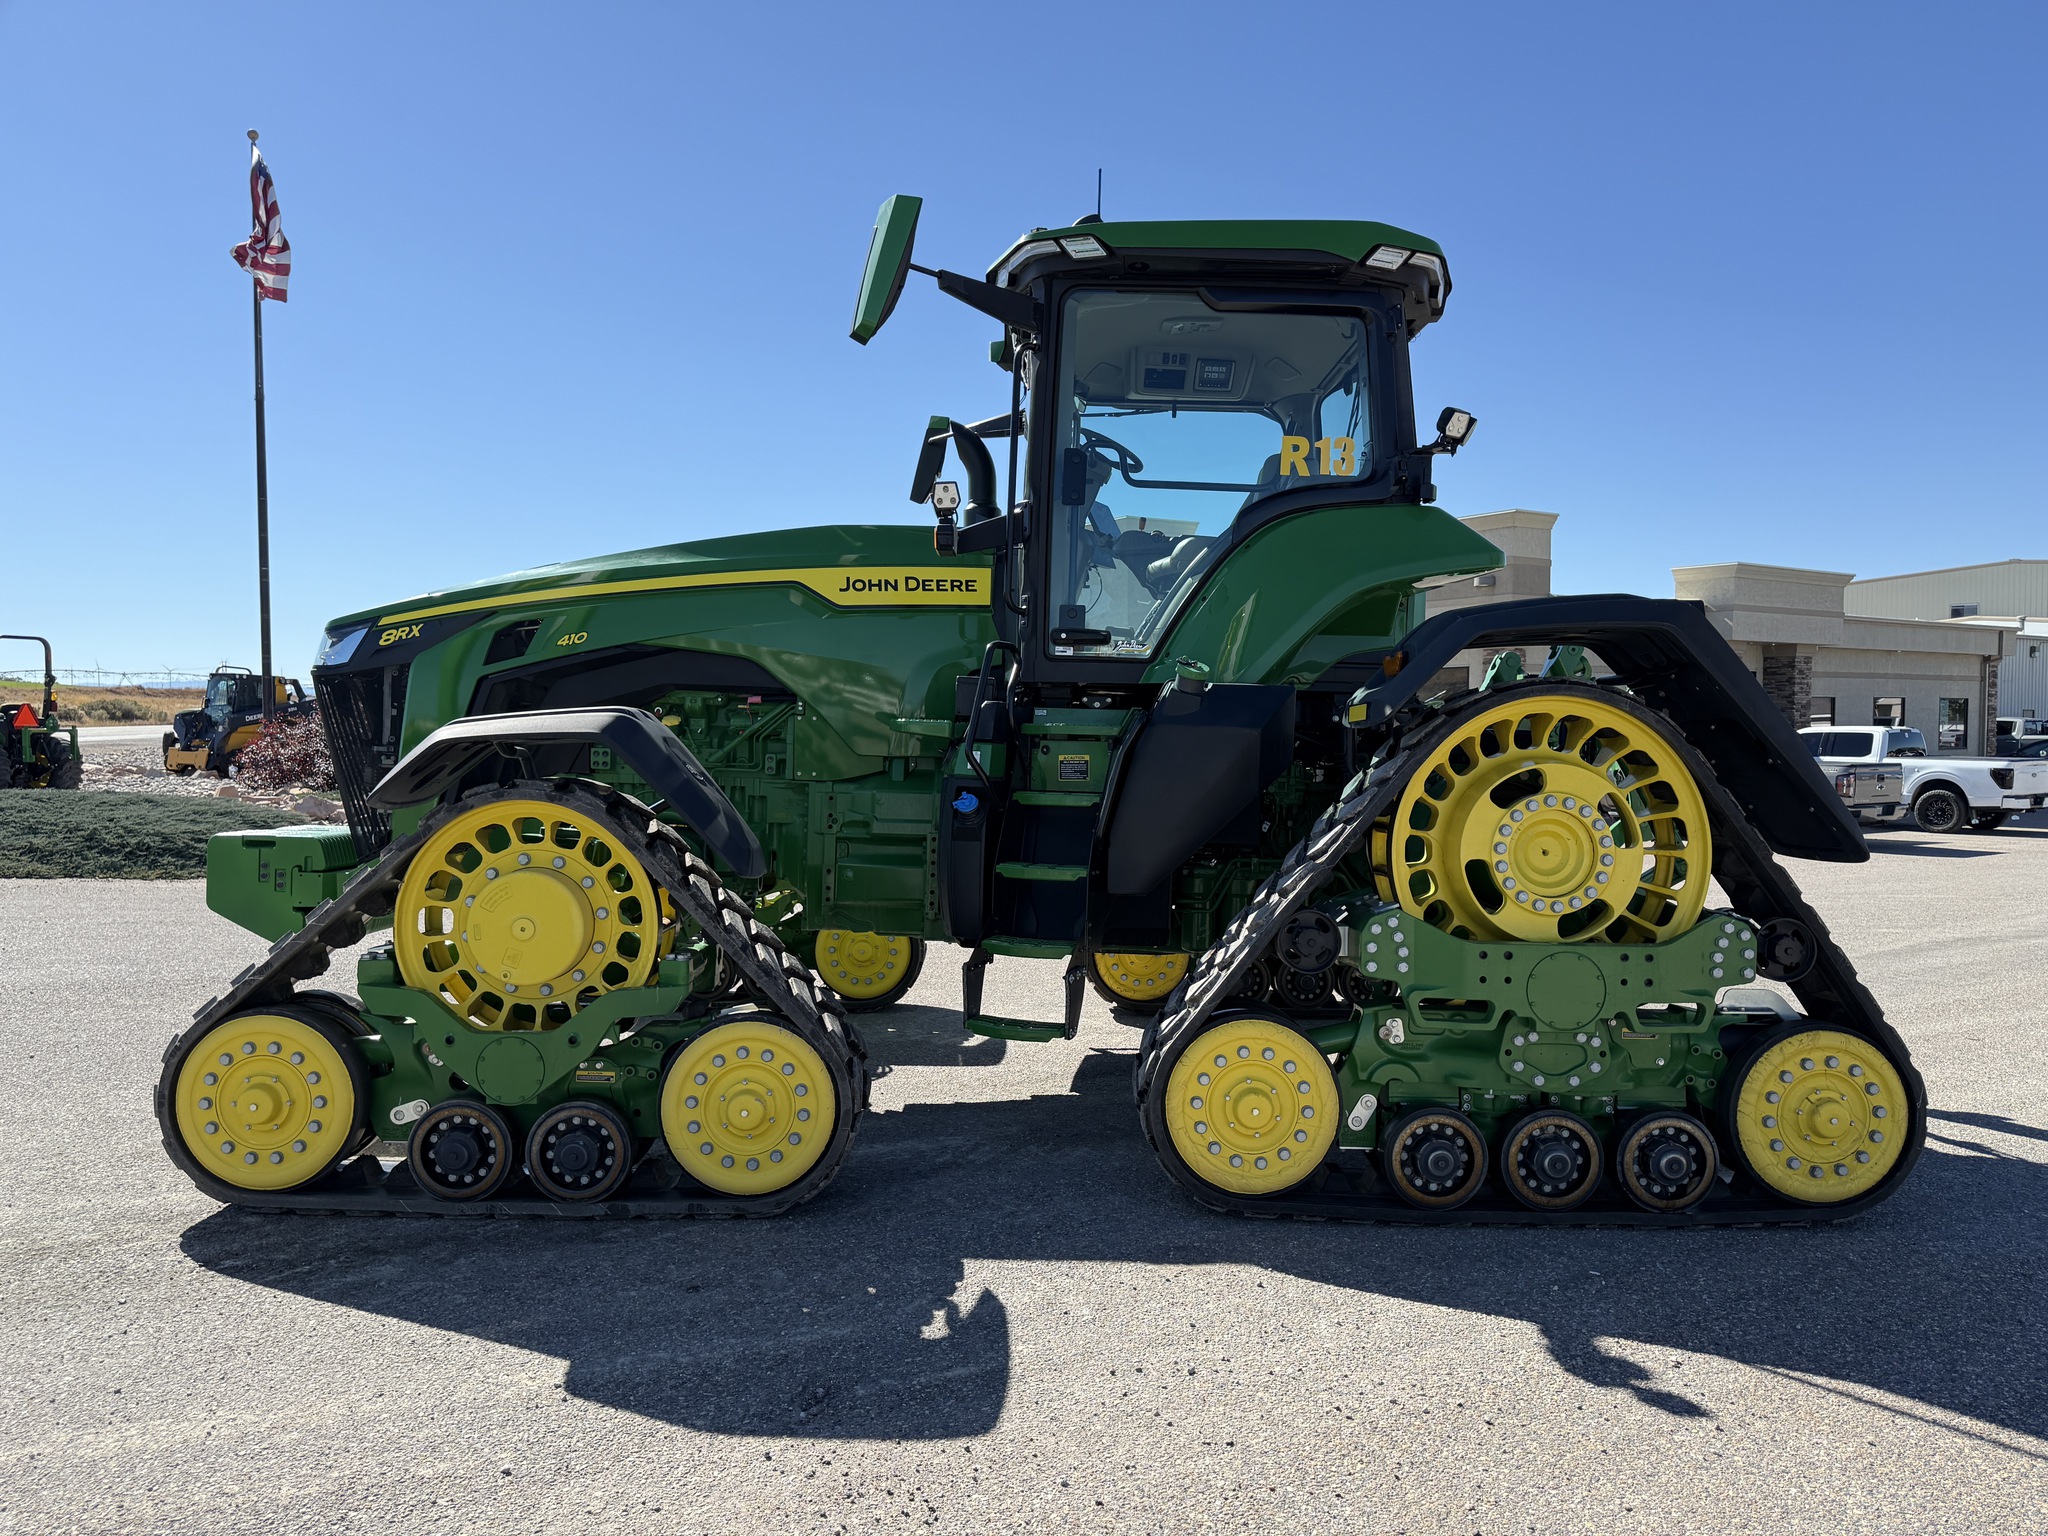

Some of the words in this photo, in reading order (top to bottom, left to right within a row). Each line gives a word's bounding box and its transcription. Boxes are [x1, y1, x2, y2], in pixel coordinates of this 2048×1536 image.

[839, 576, 899, 593] JOHN
[904, 576, 978, 593] DEERE
[378, 623, 425, 646] 8RX
[556, 631, 588, 647] 410
